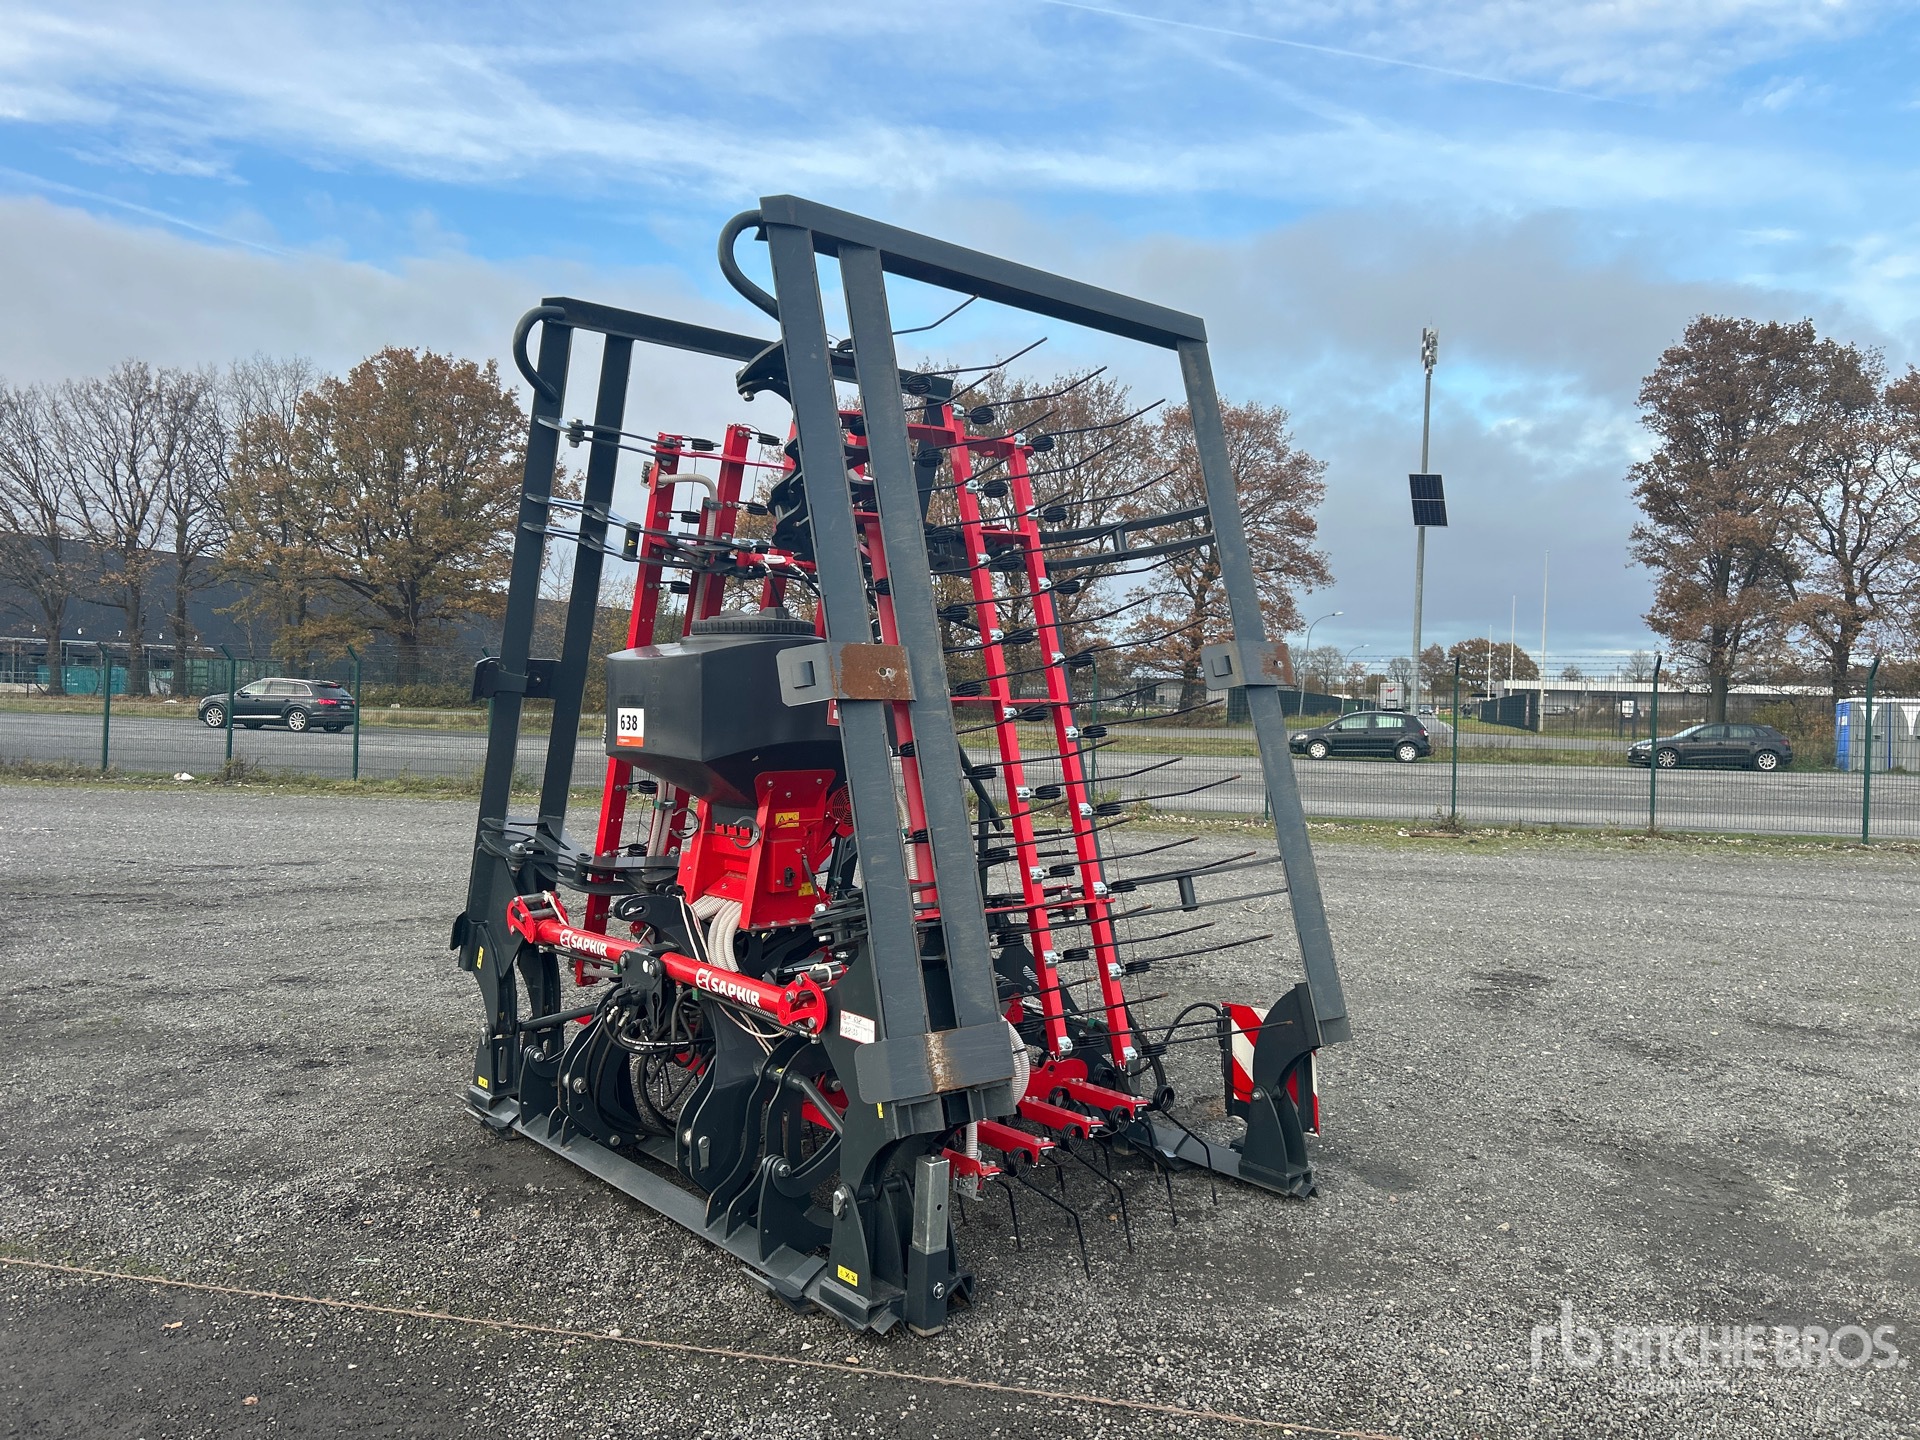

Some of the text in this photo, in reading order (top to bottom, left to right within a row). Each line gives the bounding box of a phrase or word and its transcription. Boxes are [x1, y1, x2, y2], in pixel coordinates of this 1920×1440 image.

[77, 627, 83, 635] 6
[620, 714, 638, 731] 638
[570, 935, 608, 957] SAPHIR
[710, 977, 762, 1008] SAPHIR
